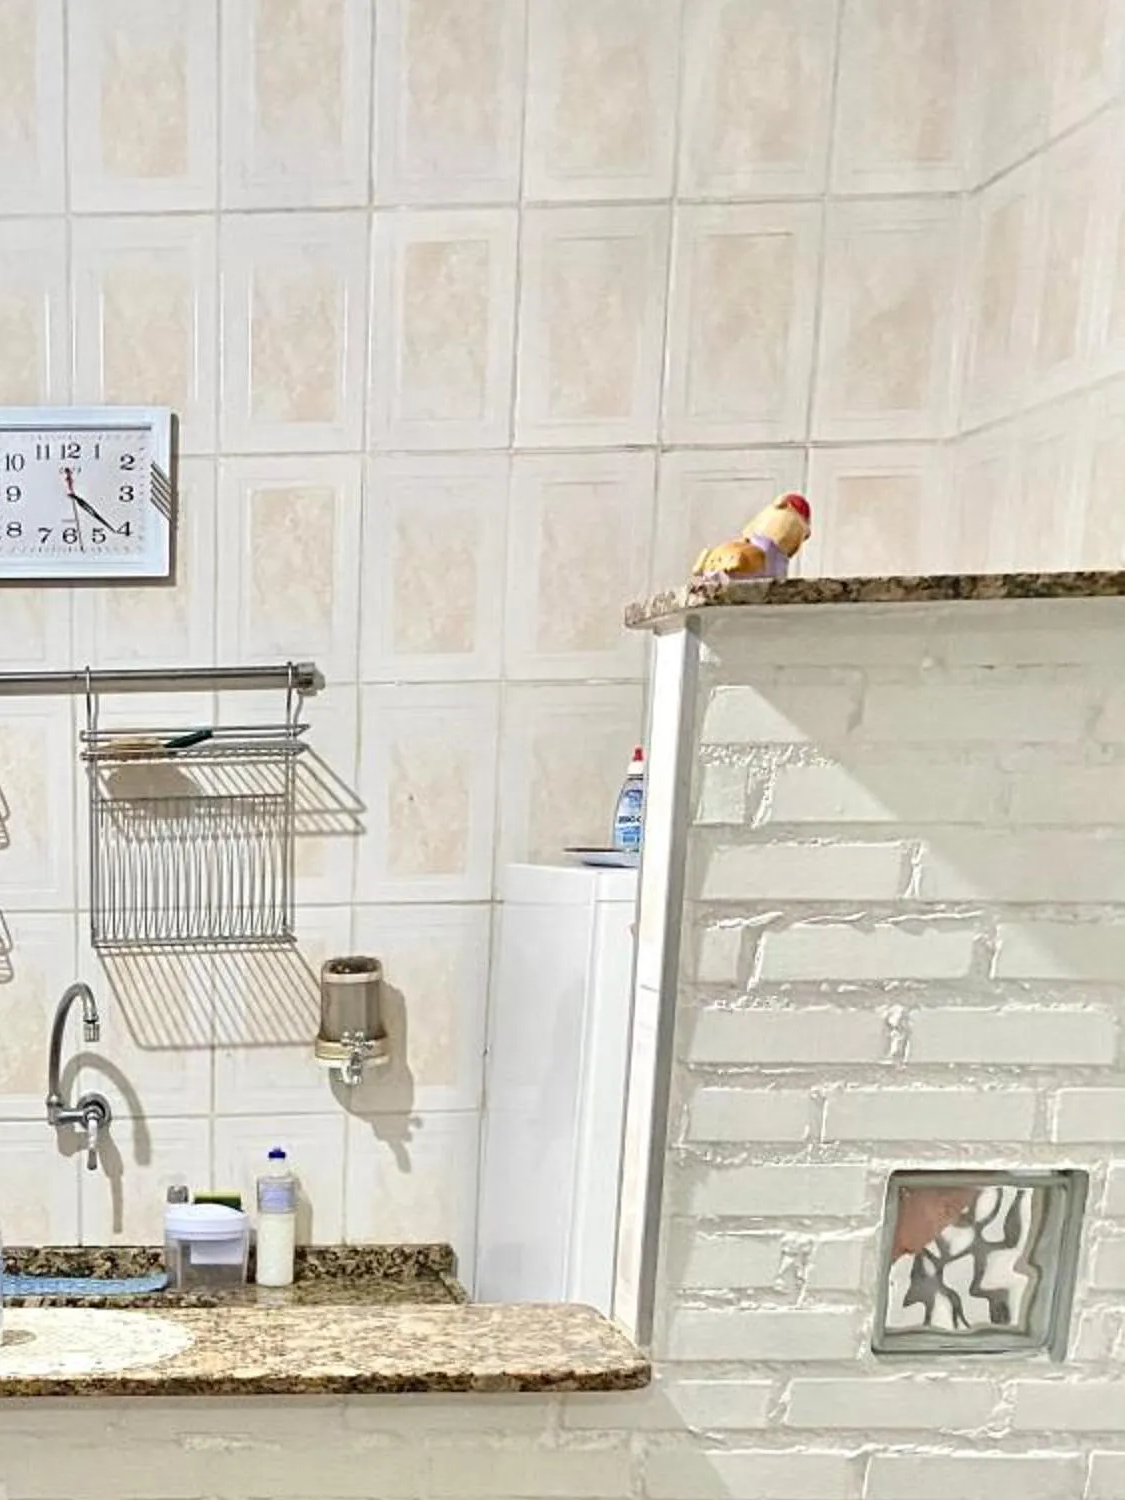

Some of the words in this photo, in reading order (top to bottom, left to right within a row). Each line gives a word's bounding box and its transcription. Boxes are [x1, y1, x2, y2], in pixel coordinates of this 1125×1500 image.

[36, 444, 50, 460] 11
[60, 443, 81, 460] 12
[94, 444, 100, 460] 1
[5, 454, 25, 472] 10
[120, 454, 135, 471] 2
[6, 486, 22, 502] 9
[119, 485, 135, 502] 3
[6, 521, 22, 538] 8
[38, 528, 54, 544] 7
[62, 528, 78, 544] 6
[91, 528, 107, 544] 5
[116, 521, 133, 537] 4
